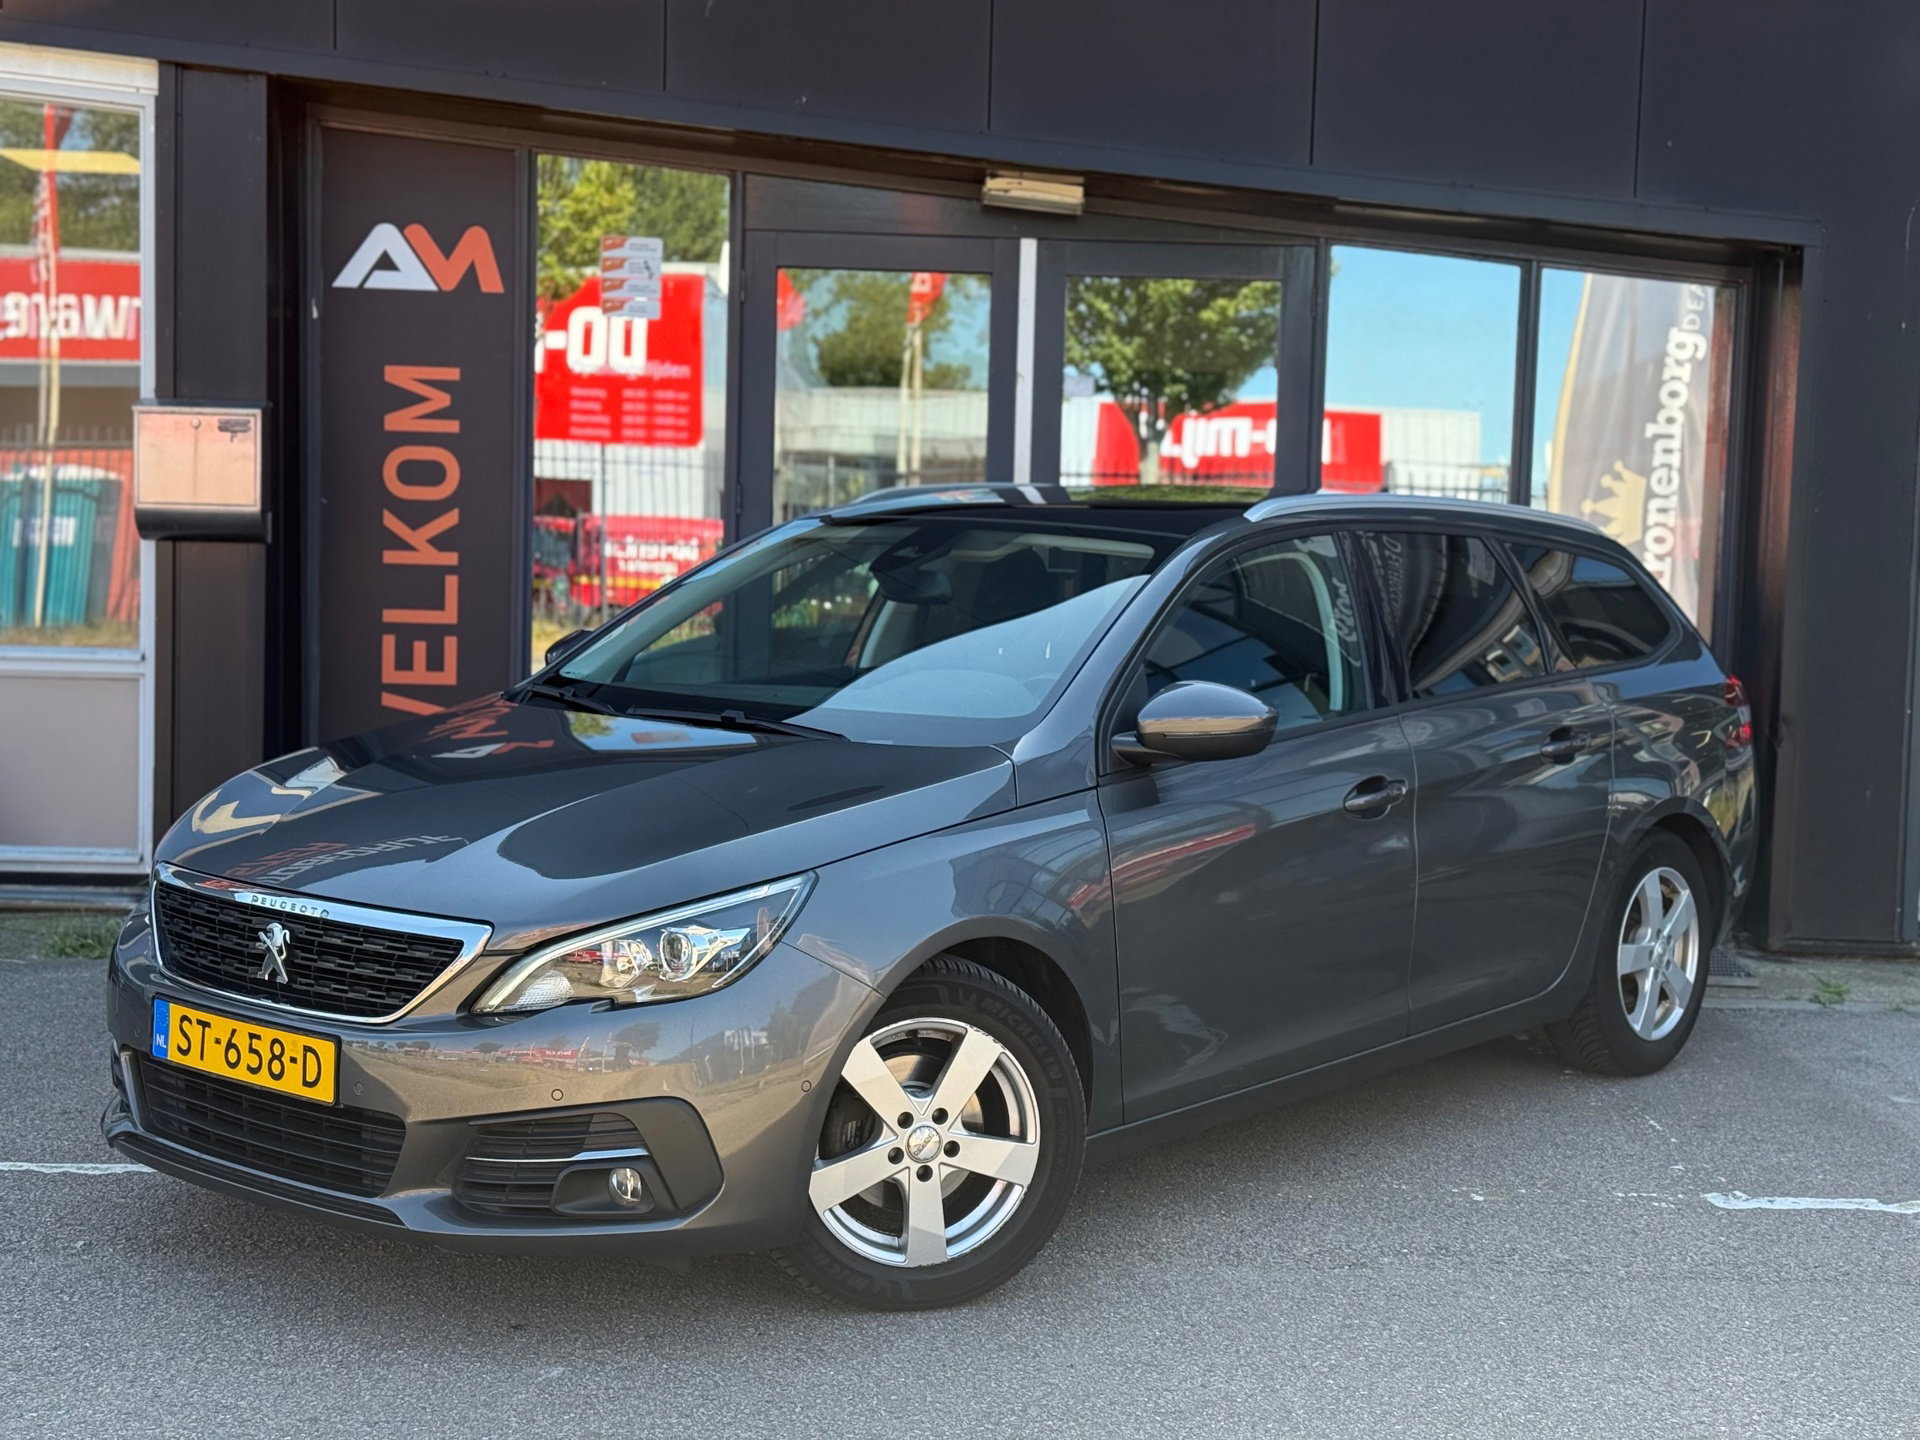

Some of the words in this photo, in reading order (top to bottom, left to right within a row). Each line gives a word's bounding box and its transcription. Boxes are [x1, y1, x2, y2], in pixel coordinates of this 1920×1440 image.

[1642, 327, 1708, 592] ronenborg
[251, 894, 318, 916] PEUGEOT
[156, 1033, 167, 1049] NL
[176, 1014, 322, 1089] ST-658-D
